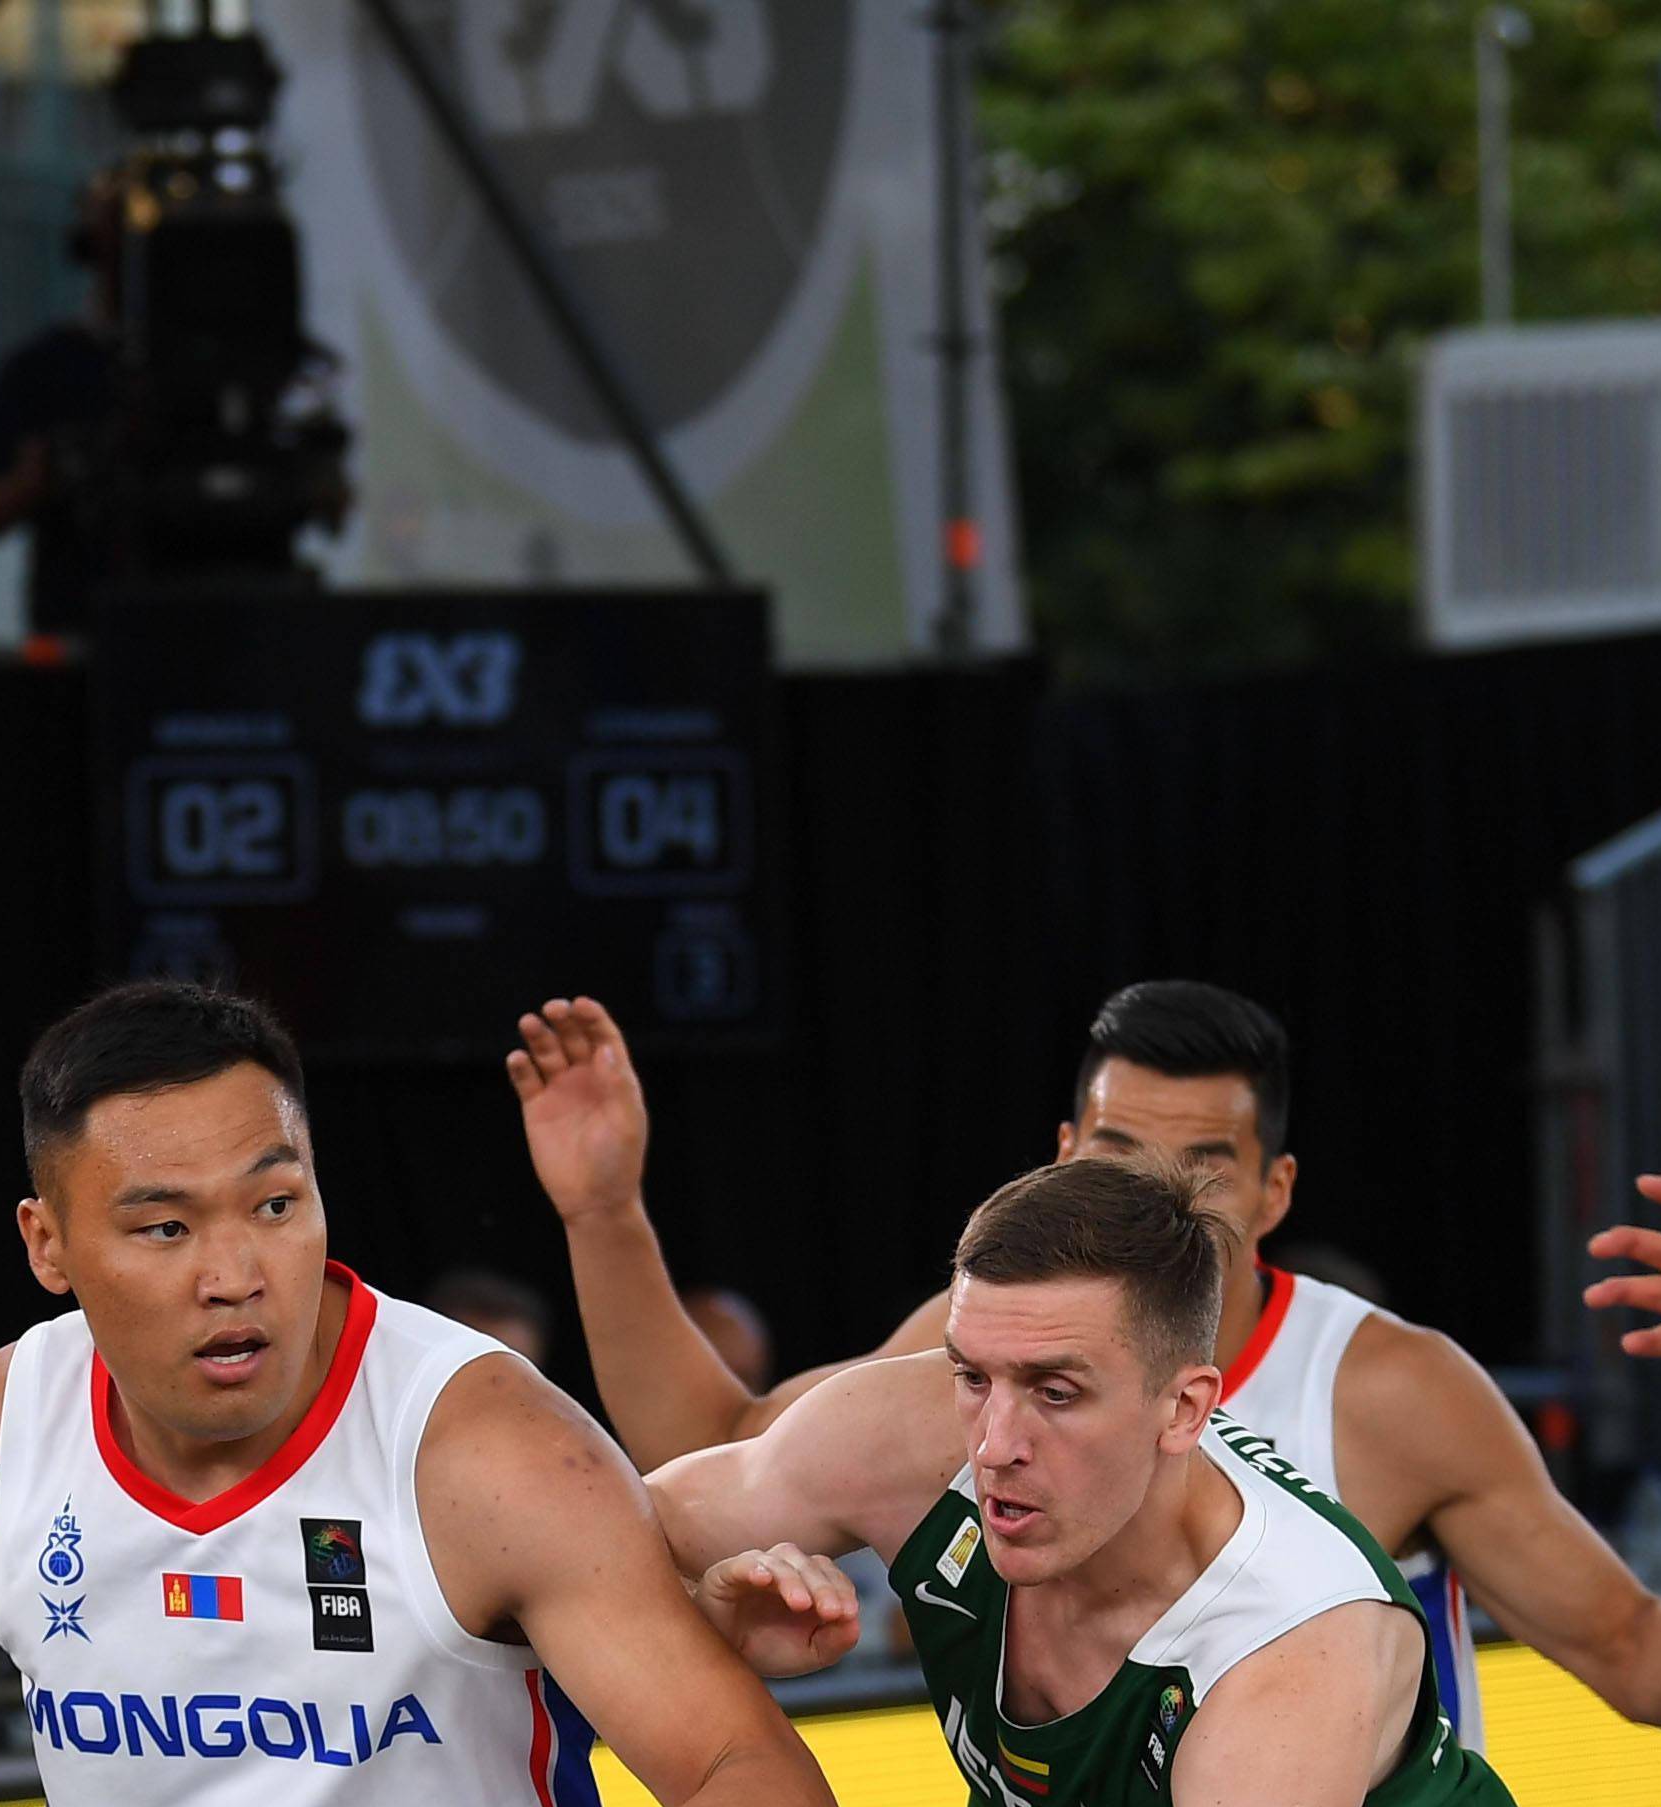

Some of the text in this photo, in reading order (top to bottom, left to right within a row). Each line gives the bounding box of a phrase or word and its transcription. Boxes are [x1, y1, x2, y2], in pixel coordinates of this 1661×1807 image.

[161, 783, 284, 874] 02
[600, 777, 720, 865] 04
[320, 1594, 362, 1618] FIBA
[30, 1689, 442, 1767] MONGOLIA
